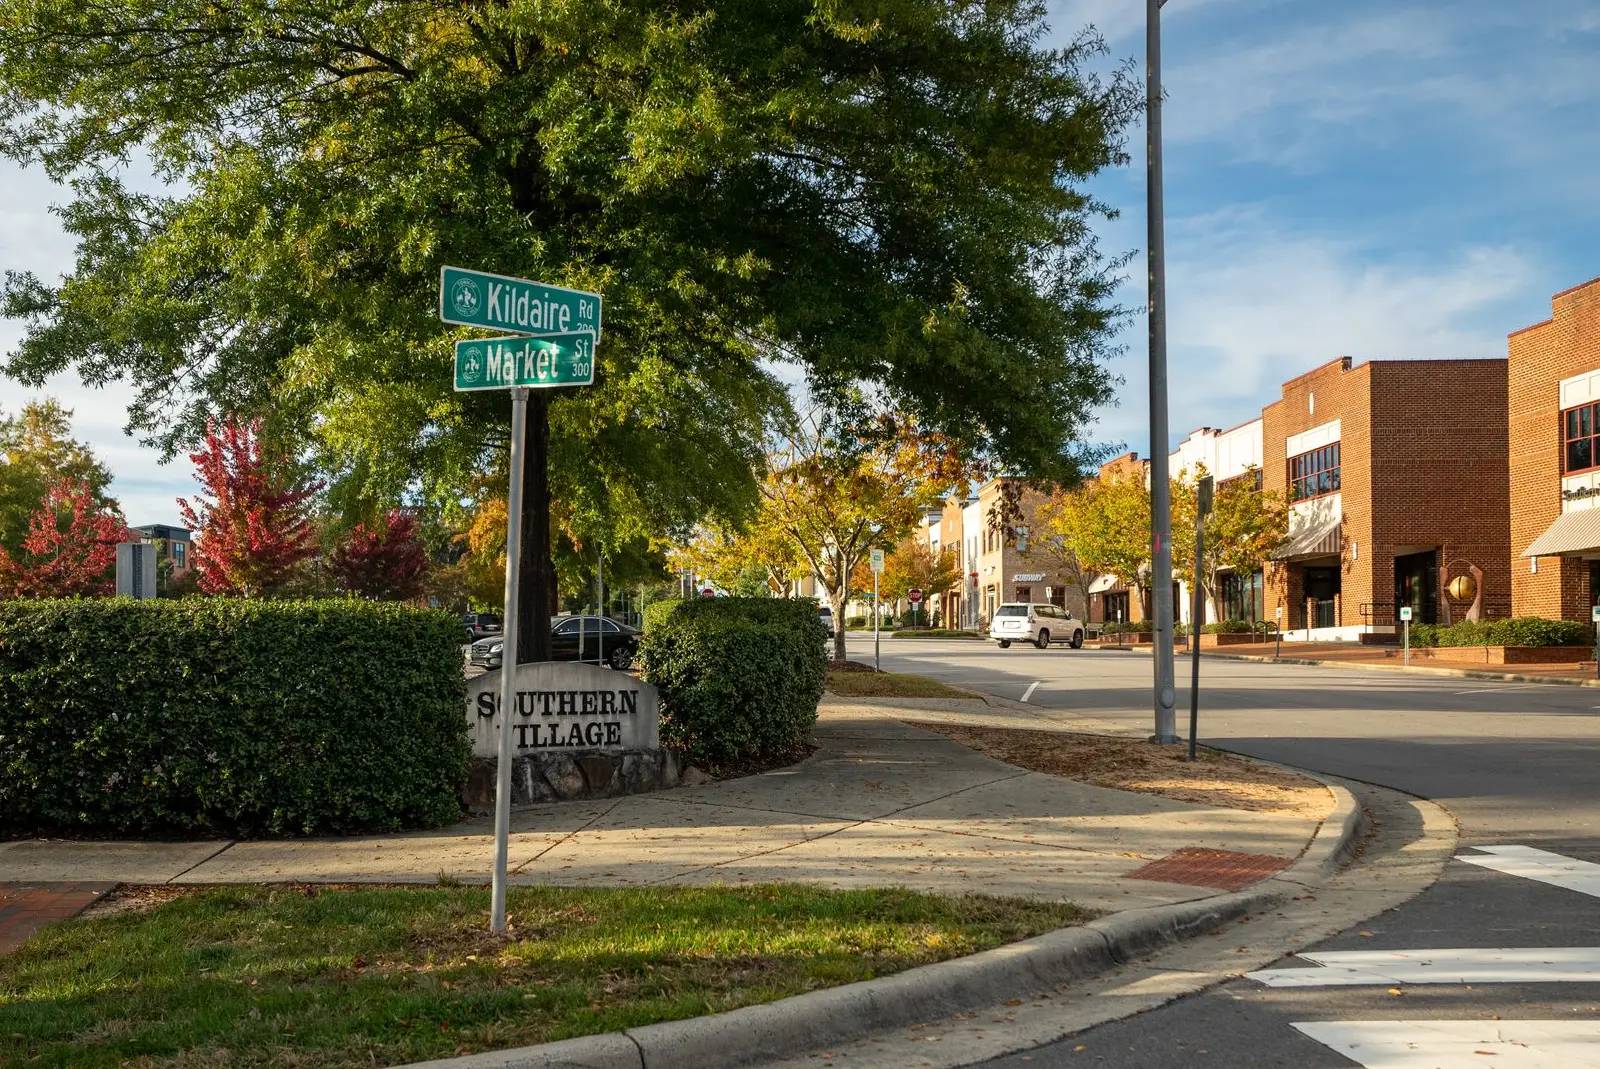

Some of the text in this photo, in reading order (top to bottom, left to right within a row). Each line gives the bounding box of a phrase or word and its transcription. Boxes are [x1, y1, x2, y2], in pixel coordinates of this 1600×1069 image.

[487, 282, 593, 333] Kildaire Rd
[486, 339, 589, 381] Market St
[571, 363, 590, 377] 300
[477, 690, 639, 718] SUTHERN
[497, 722, 621, 749] ILLAGE
